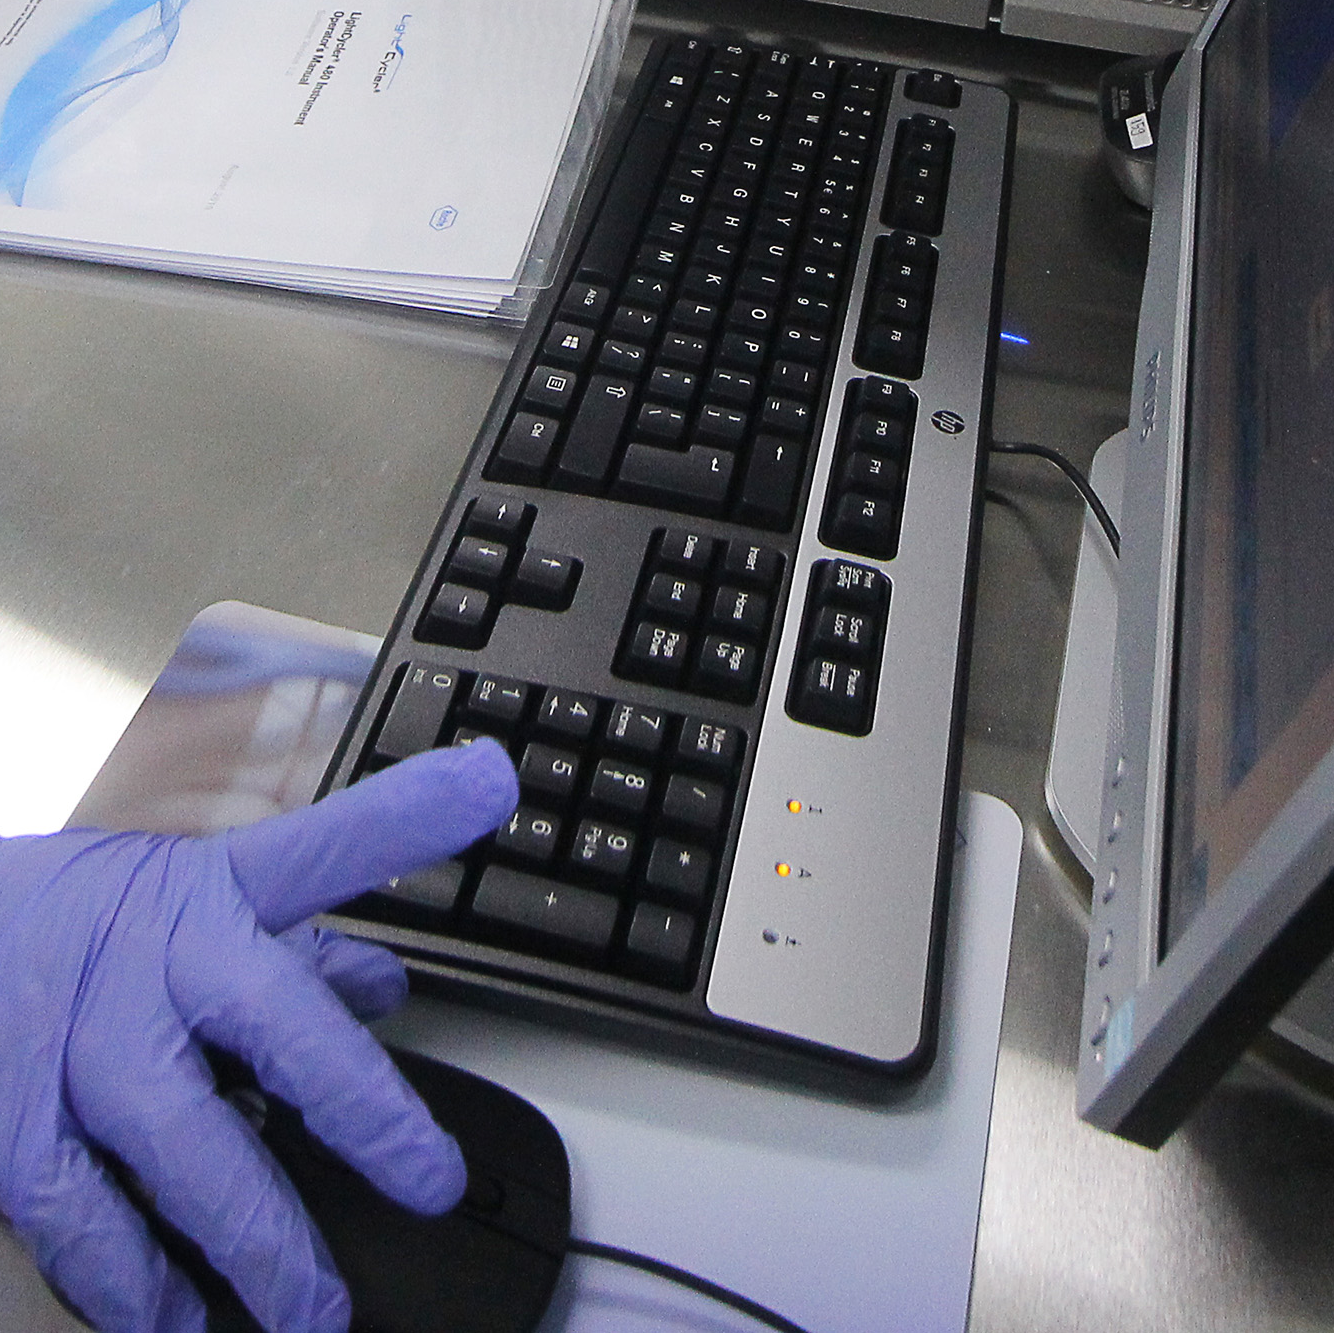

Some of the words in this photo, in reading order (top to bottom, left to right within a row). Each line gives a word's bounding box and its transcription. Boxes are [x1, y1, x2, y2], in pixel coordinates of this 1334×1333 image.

[315, 11, 345, 54] Operator's
[298, 55, 324, 86] Manual
[320, 64, 336, 80] 480
[715, 94, 731, 105] Z
[765, 89, 779, 98] A
[294, 81, 328, 126] Instrument
[843, 105, 855, 113] 2
[706, 117, 722, 128] X
[757, 113, 772, 122] S
[805, 114, 820, 124] W
[698, 142, 714, 152] C
[749, 136, 764, 147] D
[797, 137, 814, 148] E
[742, 161, 757, 171] F
[790, 162, 806, 173] R
[690, 169, 706, 178] V
[679, 193, 695, 204] B
[732, 187, 749, 199] G
[783, 190, 799, 200] T
[818, 207, 831, 215] 6
[668, 221, 686, 234] N
[724, 215, 741, 228] H
[776, 217, 792, 227] Y
[812, 236, 824, 245] 7
[716, 244, 731, 254] J
[768, 245, 785, 257] U
[657, 249, 675, 263] M
[804, 265, 817, 275] 8
[900, 265, 912, 276] F6
[705, 273, 723, 286] K
[796, 296, 810, 306] 9
[896, 296, 908, 309] F7
[694, 304, 712, 314] L
[750, 308, 768, 320] O
[788, 330, 801, 340] 0
[890, 329, 903, 342] F8
[744, 340, 760, 353] P
[875, 419, 888, 437] F10
[932, 411, 965, 435] hp
[869, 458, 882, 475] F11
[861, 499, 876, 518] F12
[744, 546, 761, 571] Insert
[670, 580, 686, 602] End
[732, 591, 749, 620] Home
[833, 612, 848, 637] Lock
[848, 616, 864, 644] Scroll
[648, 627, 667, 657] Down
[662, 631, 681, 659] Page
[715, 641, 731, 659] Up
[728, 645, 746, 672] Page
[432, 673, 452, 689] 0
[818, 660, 833, 689] Break
[845, 667, 861, 698] Pause
[479, 679, 496, 702] End
[501, 688, 521, 699] 1
[569, 701, 589, 717] 4
[614, 704, 634, 738] Home
[640, 714, 661, 731] 7
[696, 723, 713, 751] Lock
[711, 726, 727, 755] Num
[551, 758, 573, 777] 5
[624, 773, 646, 790] 8
[531, 819, 553, 837] 6
[606, 833, 628, 852] 9
